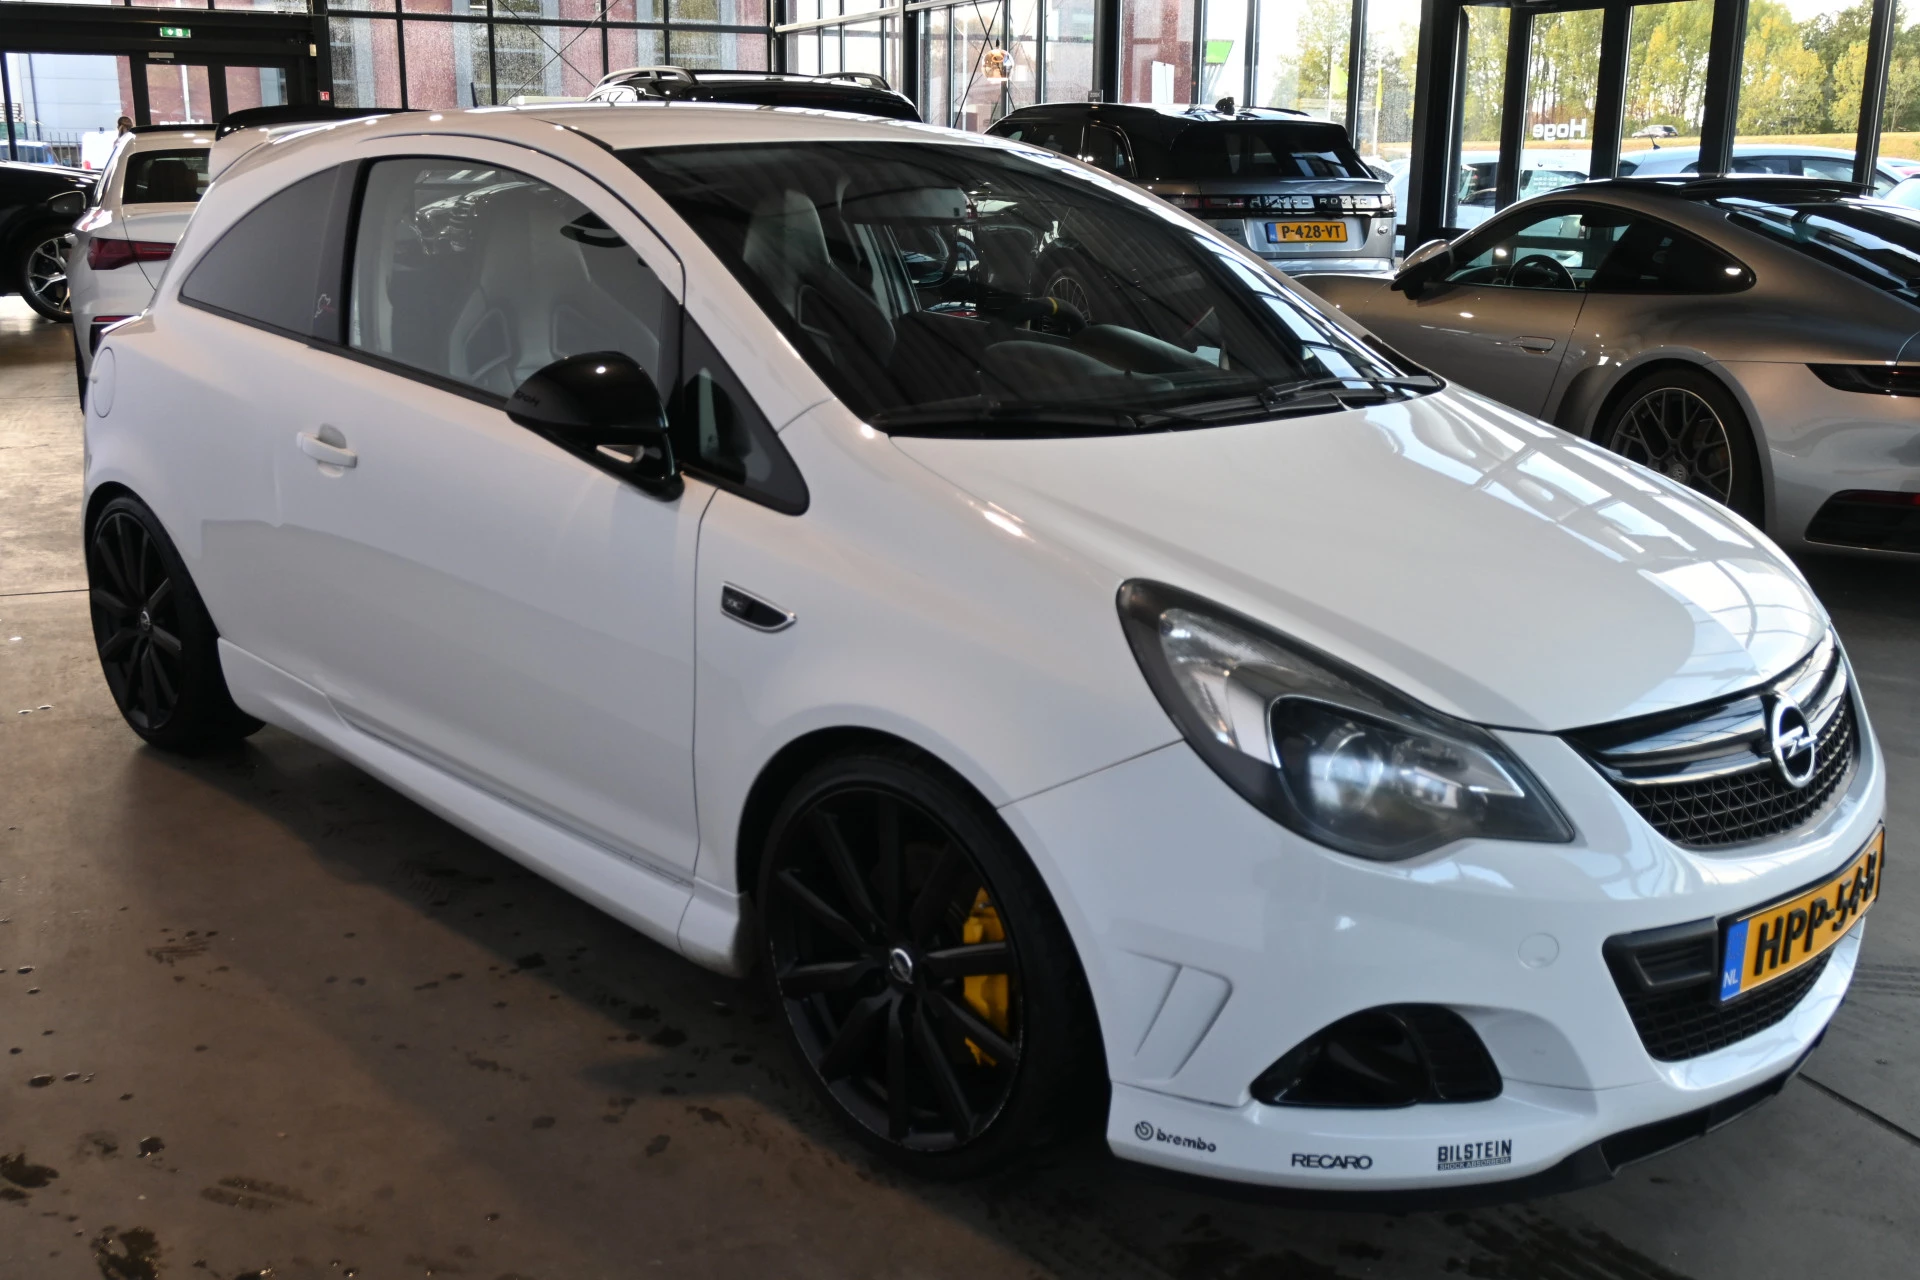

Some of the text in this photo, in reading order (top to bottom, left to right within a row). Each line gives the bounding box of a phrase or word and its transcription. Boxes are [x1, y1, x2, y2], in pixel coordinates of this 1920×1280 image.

[1281, 225, 1341, 239] P-428-VT
[1722, 968, 1739, 989] NL
[1156, 1129, 1217, 1153] brembo
[1437, 1139, 1513, 1162] BILSTEIN
[1291, 1153, 1373, 1170] RECARO
